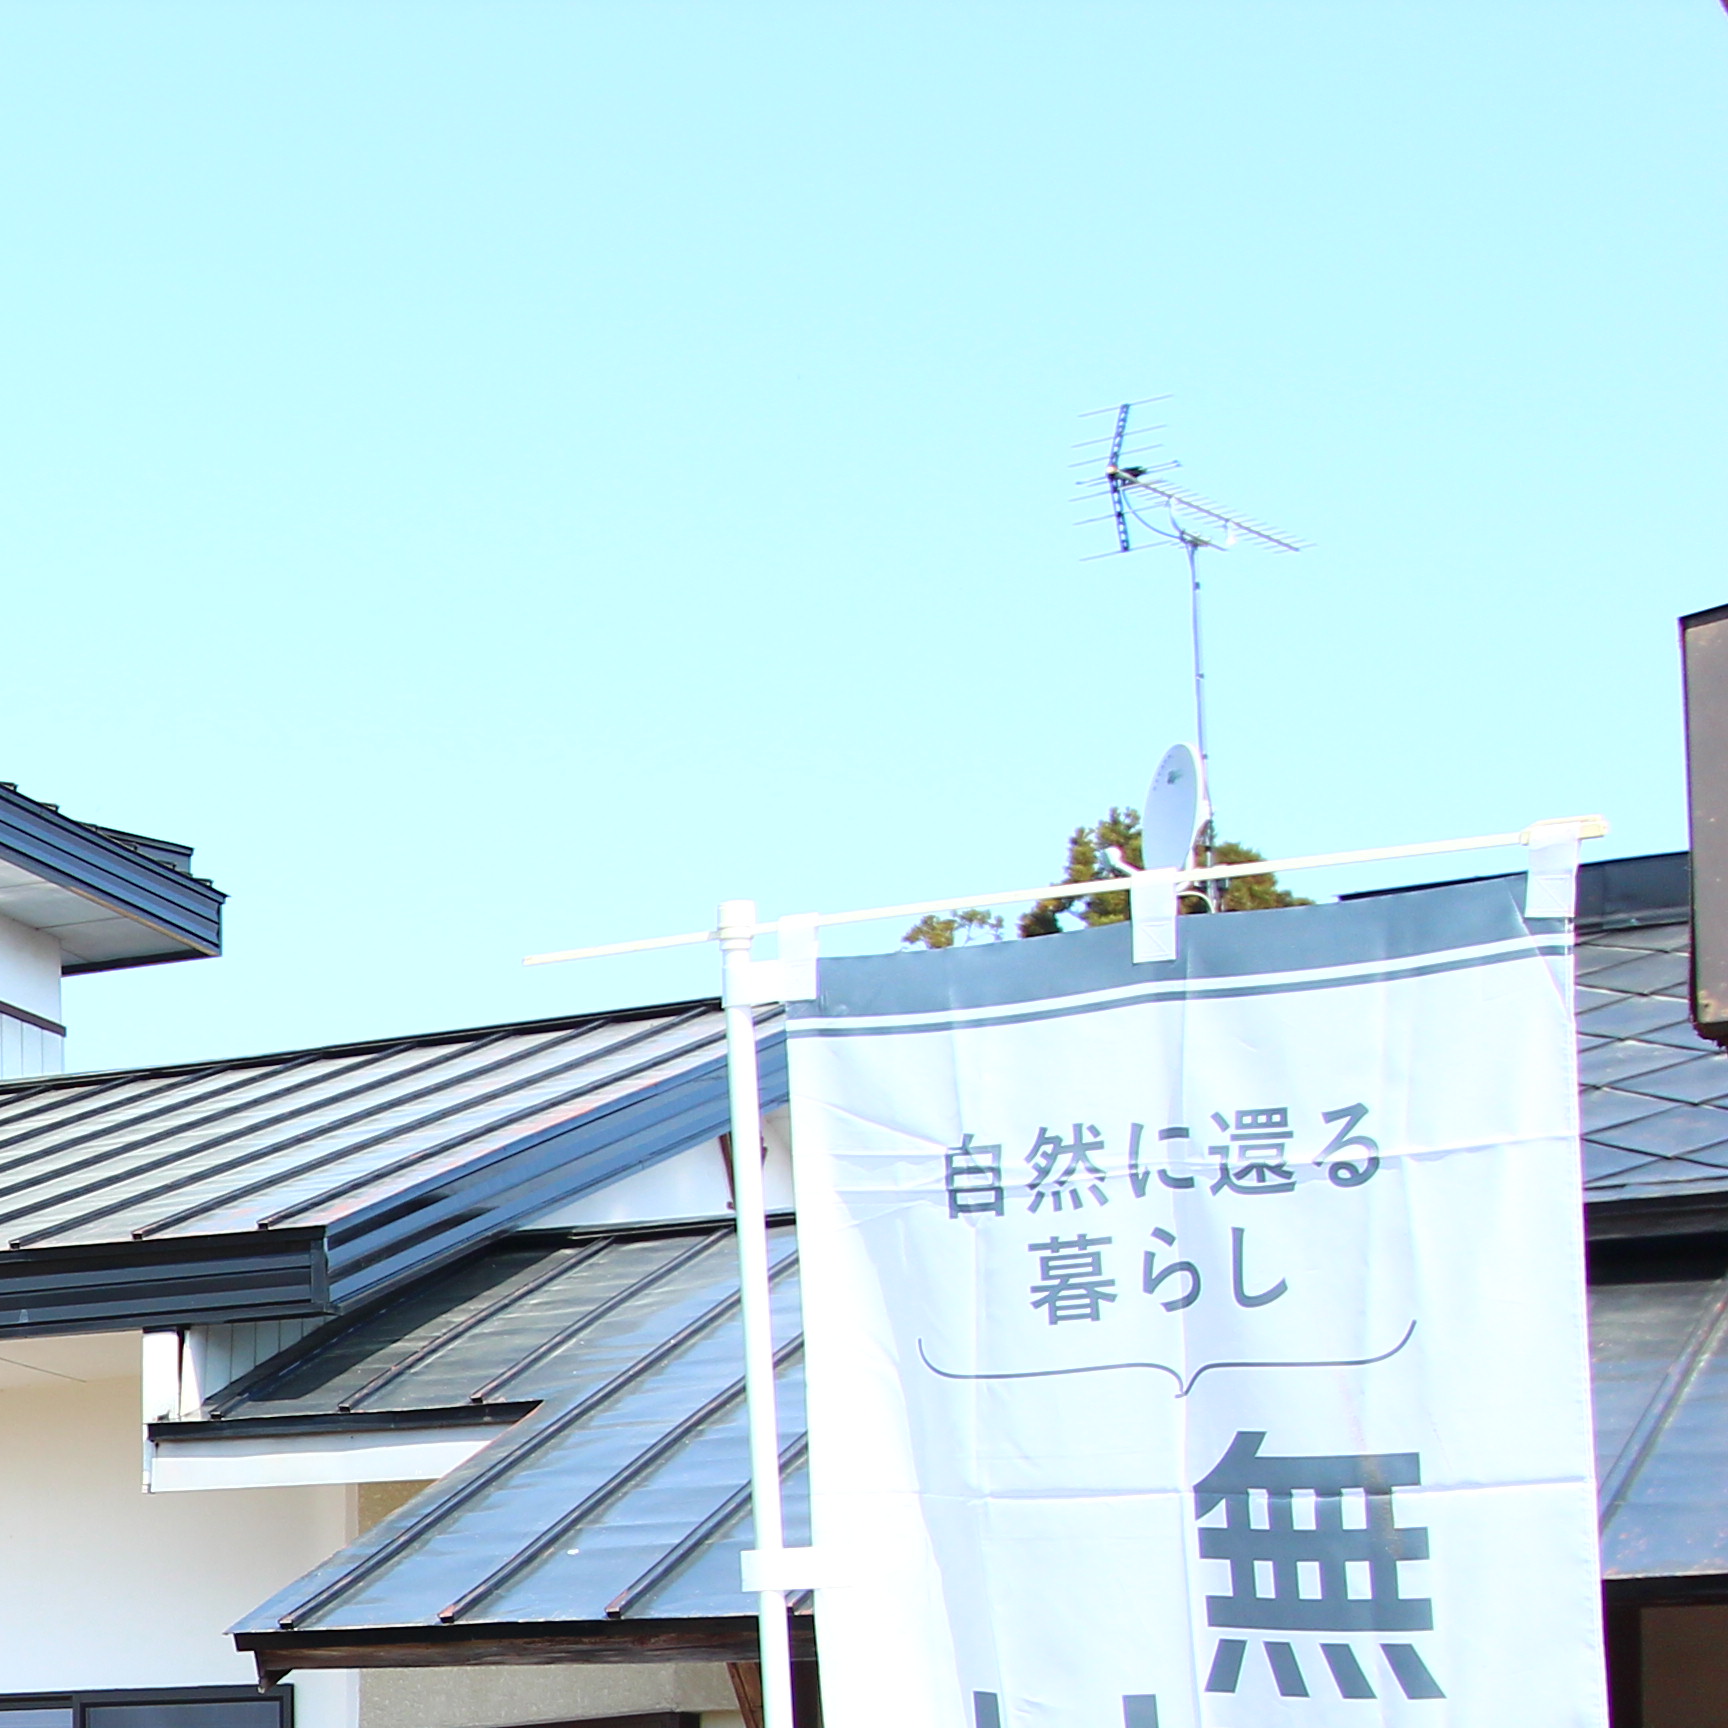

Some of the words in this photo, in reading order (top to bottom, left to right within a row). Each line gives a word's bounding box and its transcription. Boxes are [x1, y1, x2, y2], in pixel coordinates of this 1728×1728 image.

[941, 1101, 1384, 1220] 自然に還る
[1027, 1226, 1290, 1327] 暮らし
